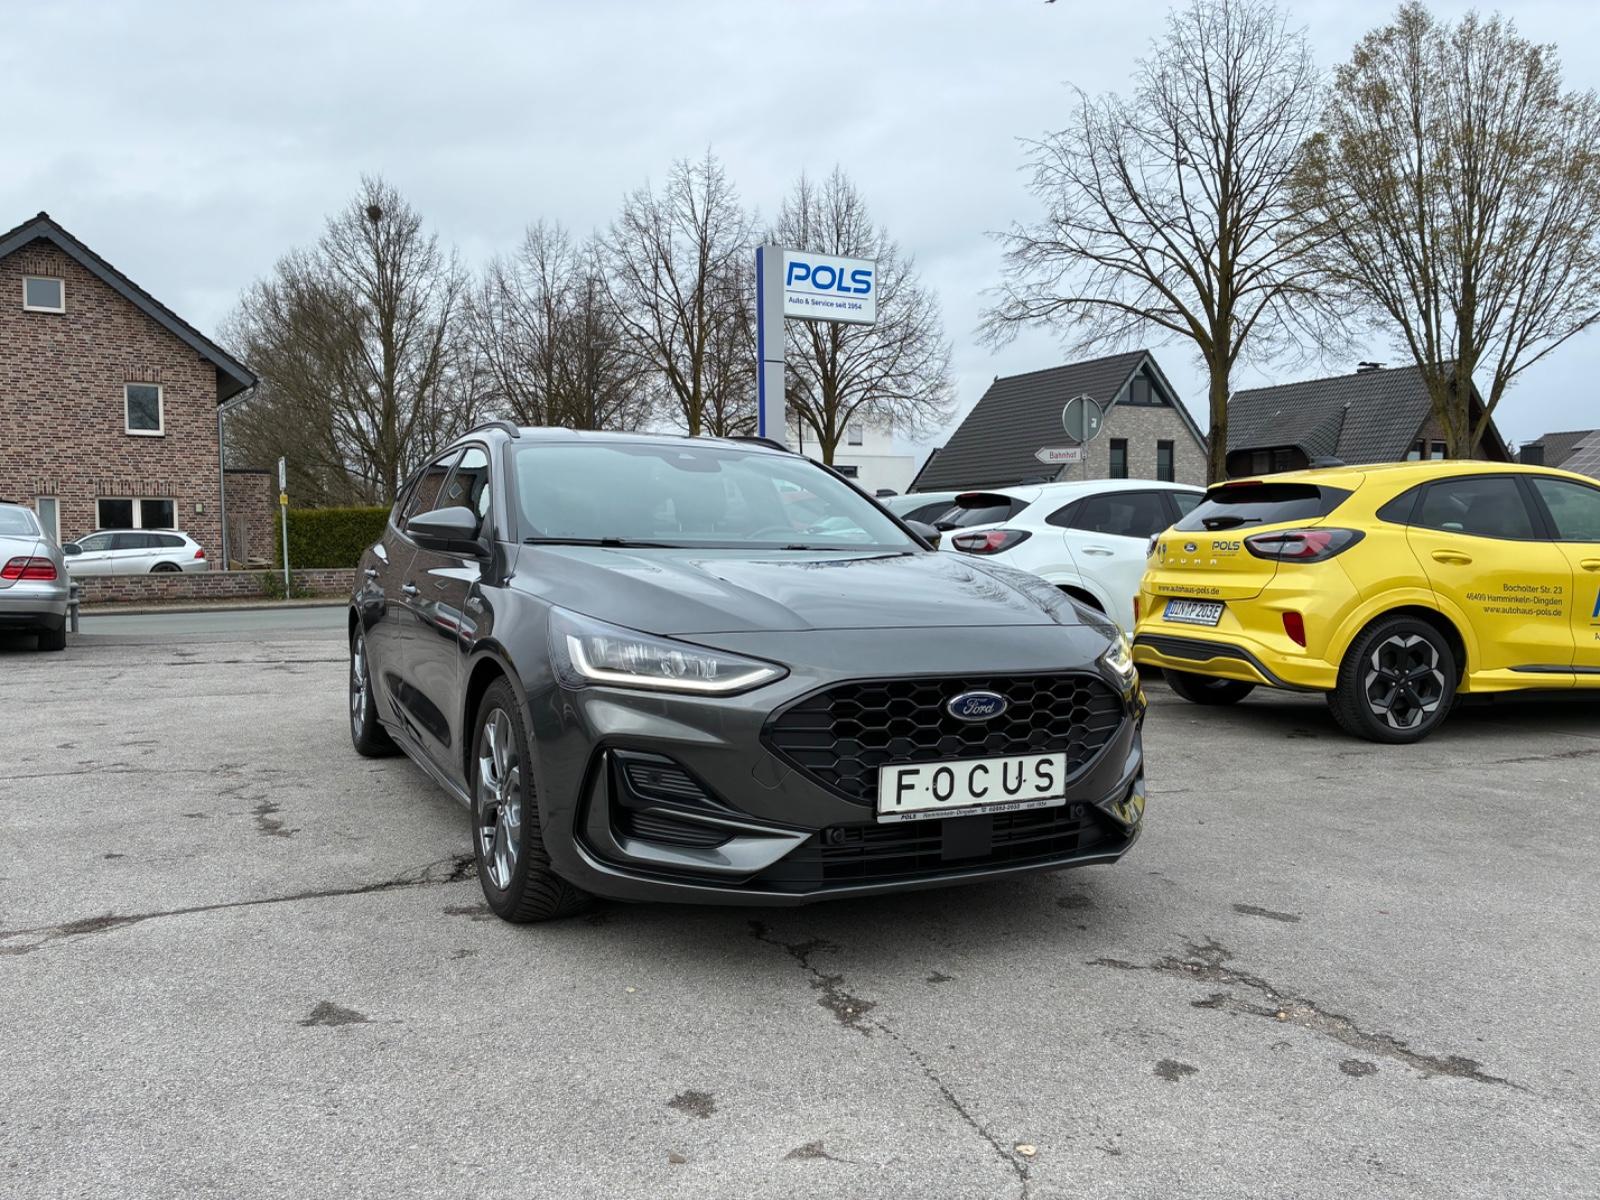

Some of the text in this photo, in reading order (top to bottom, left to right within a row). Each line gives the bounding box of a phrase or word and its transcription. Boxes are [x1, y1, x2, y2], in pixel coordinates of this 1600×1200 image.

[786, 261, 872, 294] POLS
[788, 296, 804, 305] Auto
[811, 299, 835, 308] Service
[848, 302, 862, 310] 1954
[1049, 451, 1077, 459] Bahnhof
[1212, 541, 1241, 551] POLS
[1158, 585, 1220, 595] www.autohaus-pols.de
[1503, 583, 1563, 594] Bocholter Str. 23
[1487, 594, 1563, 606] Hamminkeln-Dingden
[1483, 606, 1562, 616] www.autohaus-pols.de
[963, 697, 995, 715] Ford
[896, 758, 1055, 805] FOCUS
